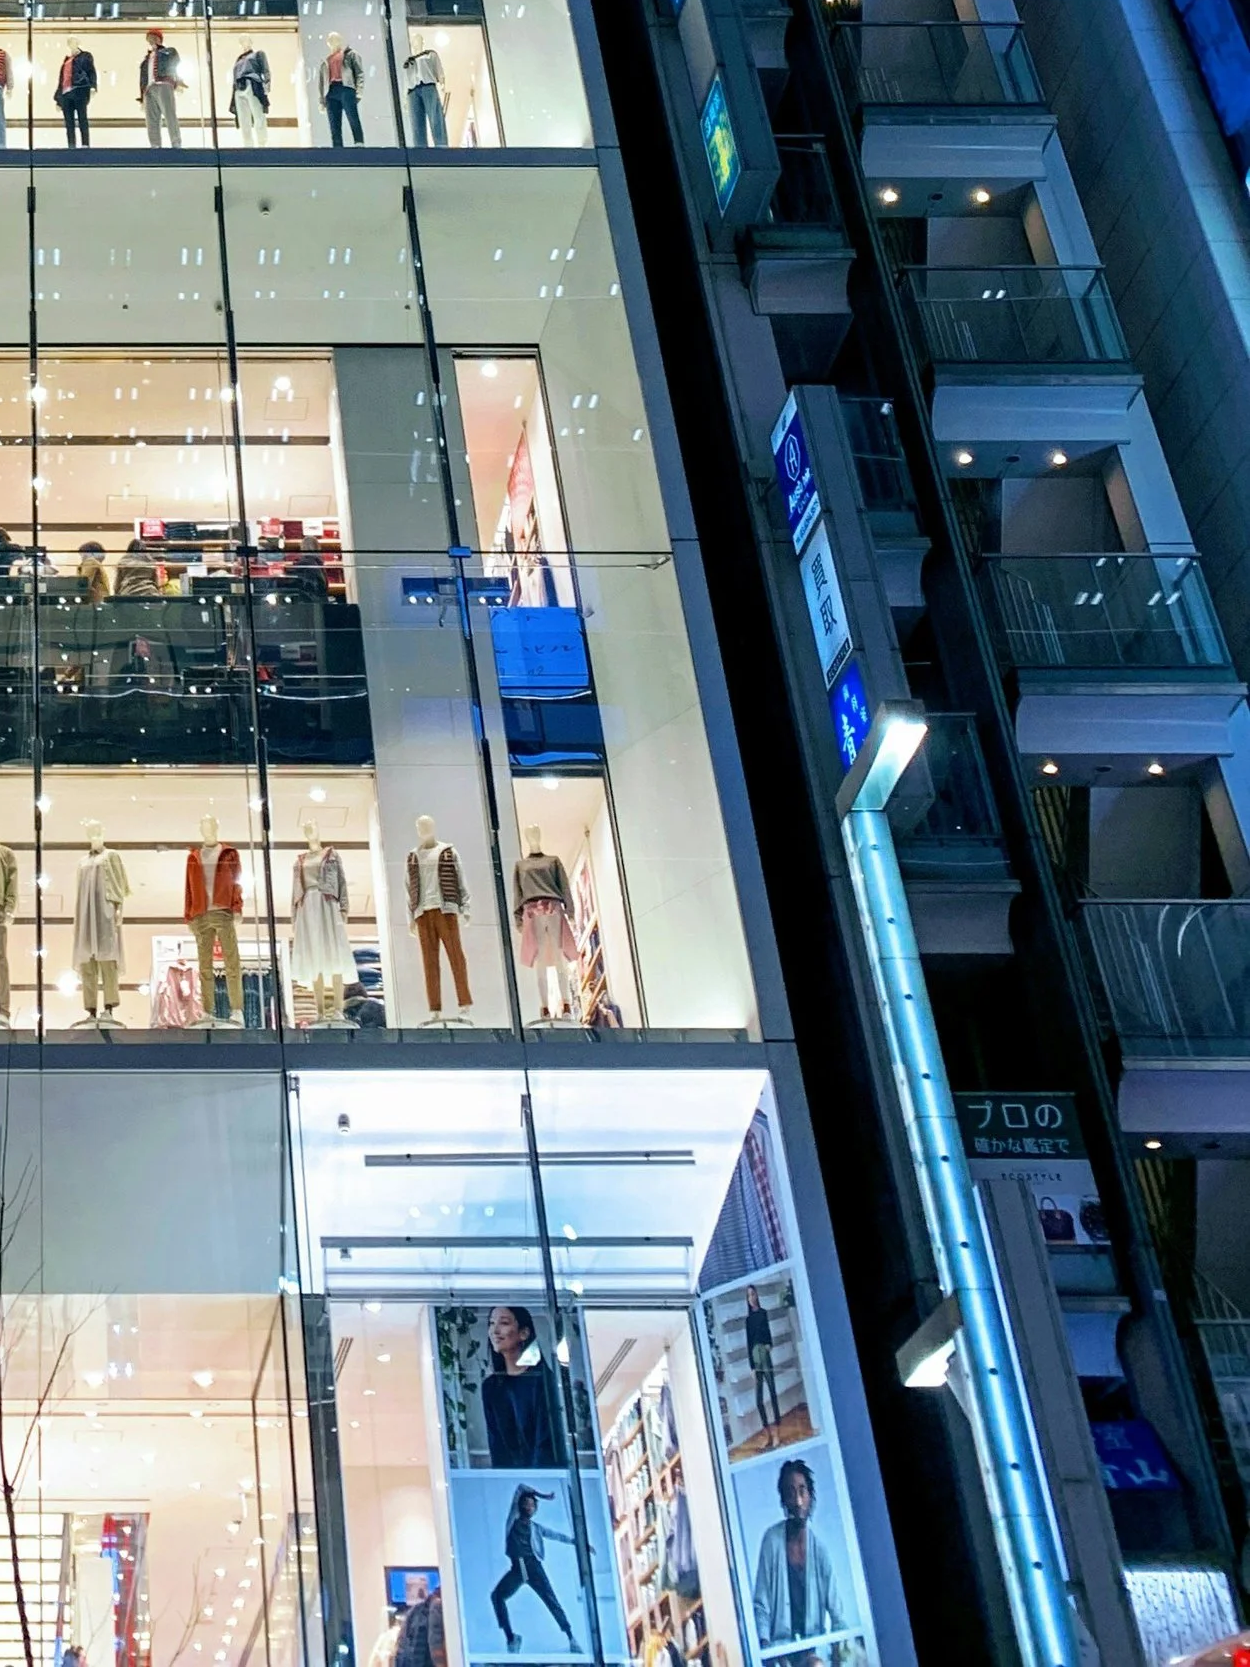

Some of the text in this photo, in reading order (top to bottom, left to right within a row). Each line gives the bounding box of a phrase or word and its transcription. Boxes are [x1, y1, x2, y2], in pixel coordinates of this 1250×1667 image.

[811, 552, 838, 637] 買取
[967, 1100, 1063, 1129] プロの
[974, 1136, 1070, 1155] 確かな鑑定で
